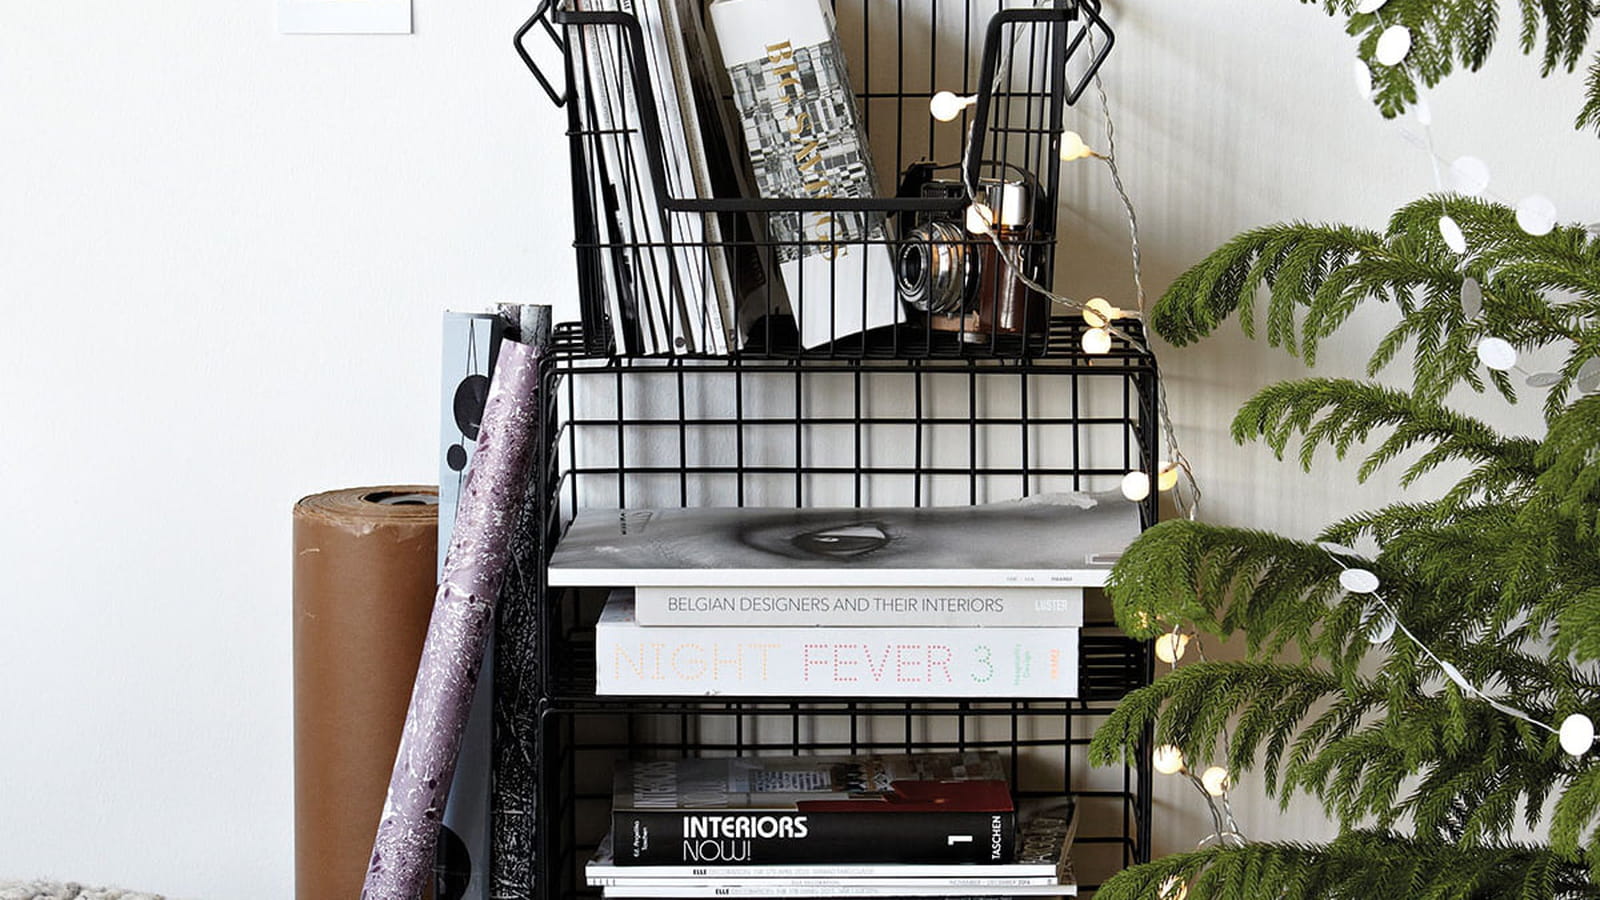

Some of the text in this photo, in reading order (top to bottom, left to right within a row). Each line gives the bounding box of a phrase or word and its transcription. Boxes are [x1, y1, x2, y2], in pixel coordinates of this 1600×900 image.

[765, 39, 804, 103] BIG
[668, 597, 1004, 613] BELGIAN DESIGNERS AND THEIR INTERIORS
[612, 642, 994, 683] NIGHT FEVER 3
[683, 816, 808, 839] INTERIORS
[991, 815, 1001, 860] TASCHEN
[683, 839, 751, 862] NOW!
[947, 835, 973, 846] 1
